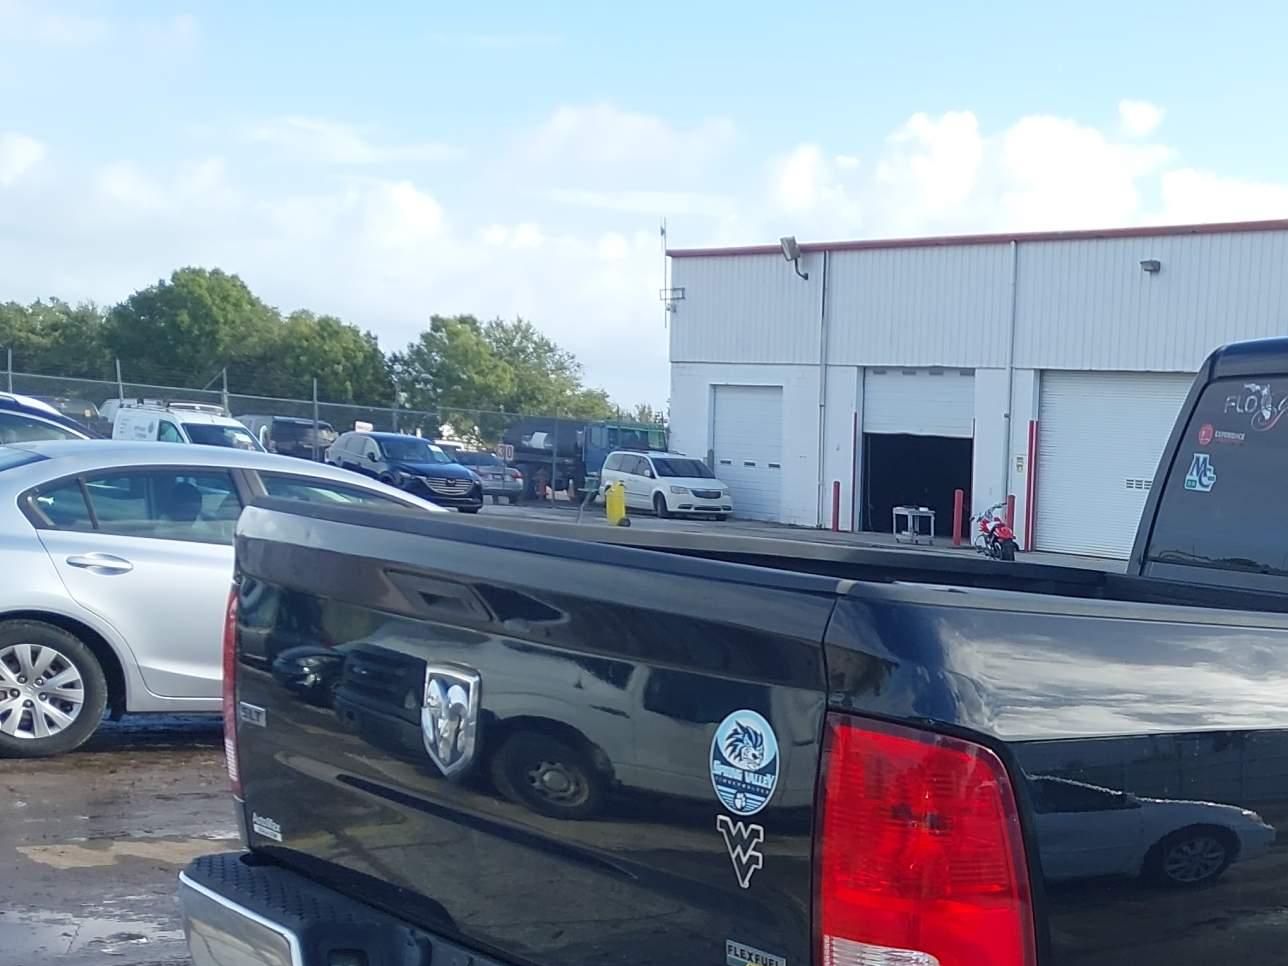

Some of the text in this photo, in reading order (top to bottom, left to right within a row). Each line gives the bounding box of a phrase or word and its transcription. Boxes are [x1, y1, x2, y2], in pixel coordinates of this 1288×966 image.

[1224, 396, 1258, 413] FLO
[240, 706, 263, 723] SLT
[745, 771, 777, 789] VALLEY
